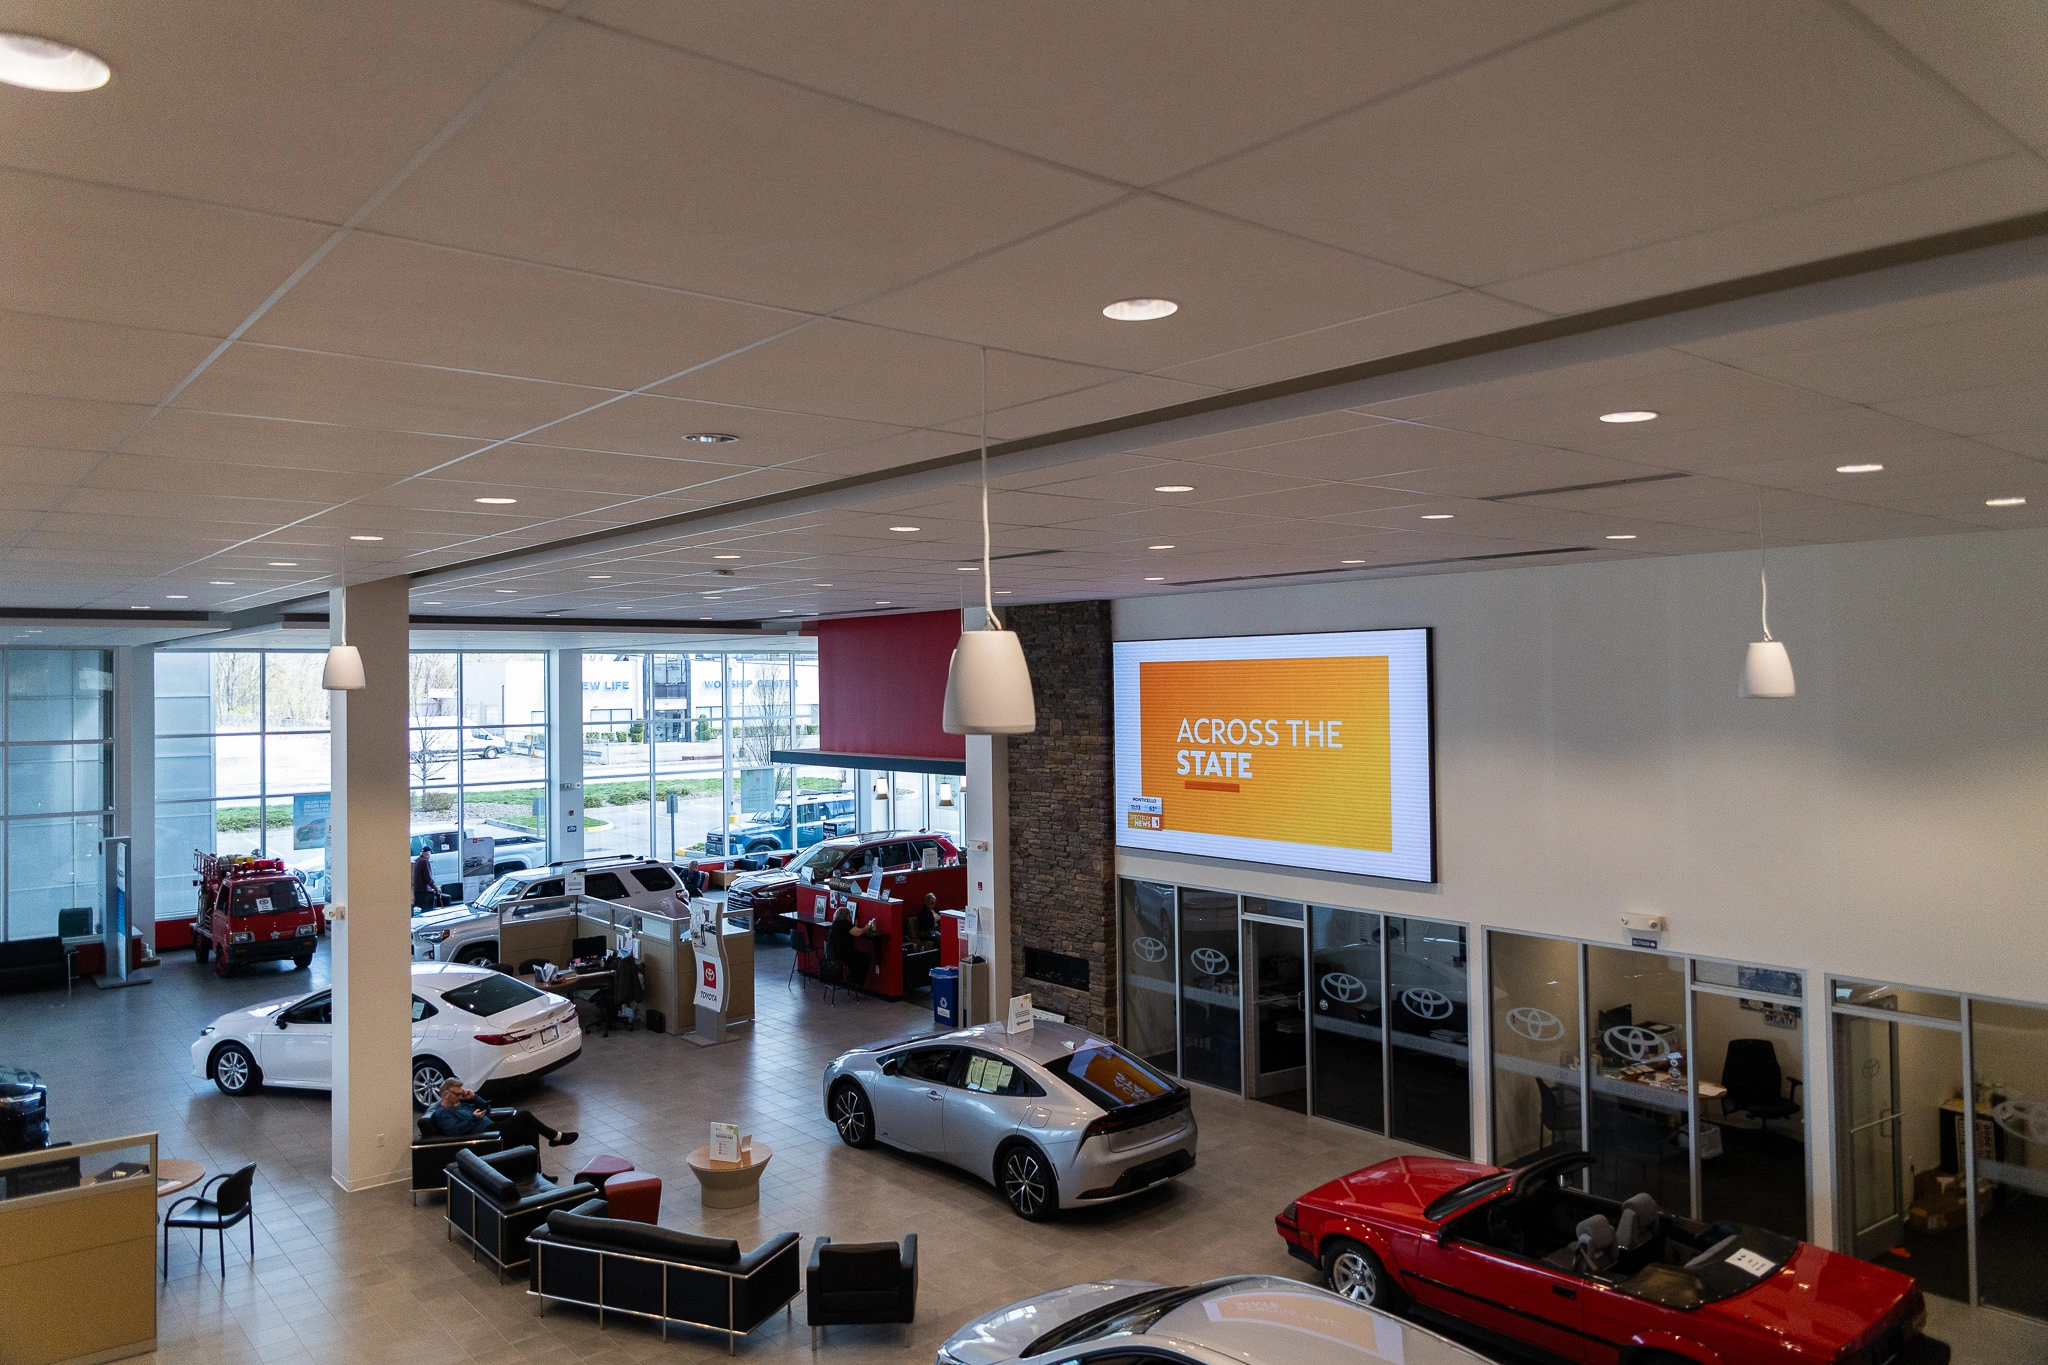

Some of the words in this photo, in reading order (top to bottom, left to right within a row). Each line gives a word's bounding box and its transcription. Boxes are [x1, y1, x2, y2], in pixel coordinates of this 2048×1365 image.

[582, 681, 601, 690] EW
[604, 681, 629, 690] LIFE
[703, 679, 753, 689] WOSHIP
[1176, 717, 1279, 746] ACROSS
[1285, 719, 1343, 748] THE
[1176, 749, 1253, 778] STATE
[1134, 820, 1151, 828] NEWS
[700, 990, 717, 1003] TOYOTA
